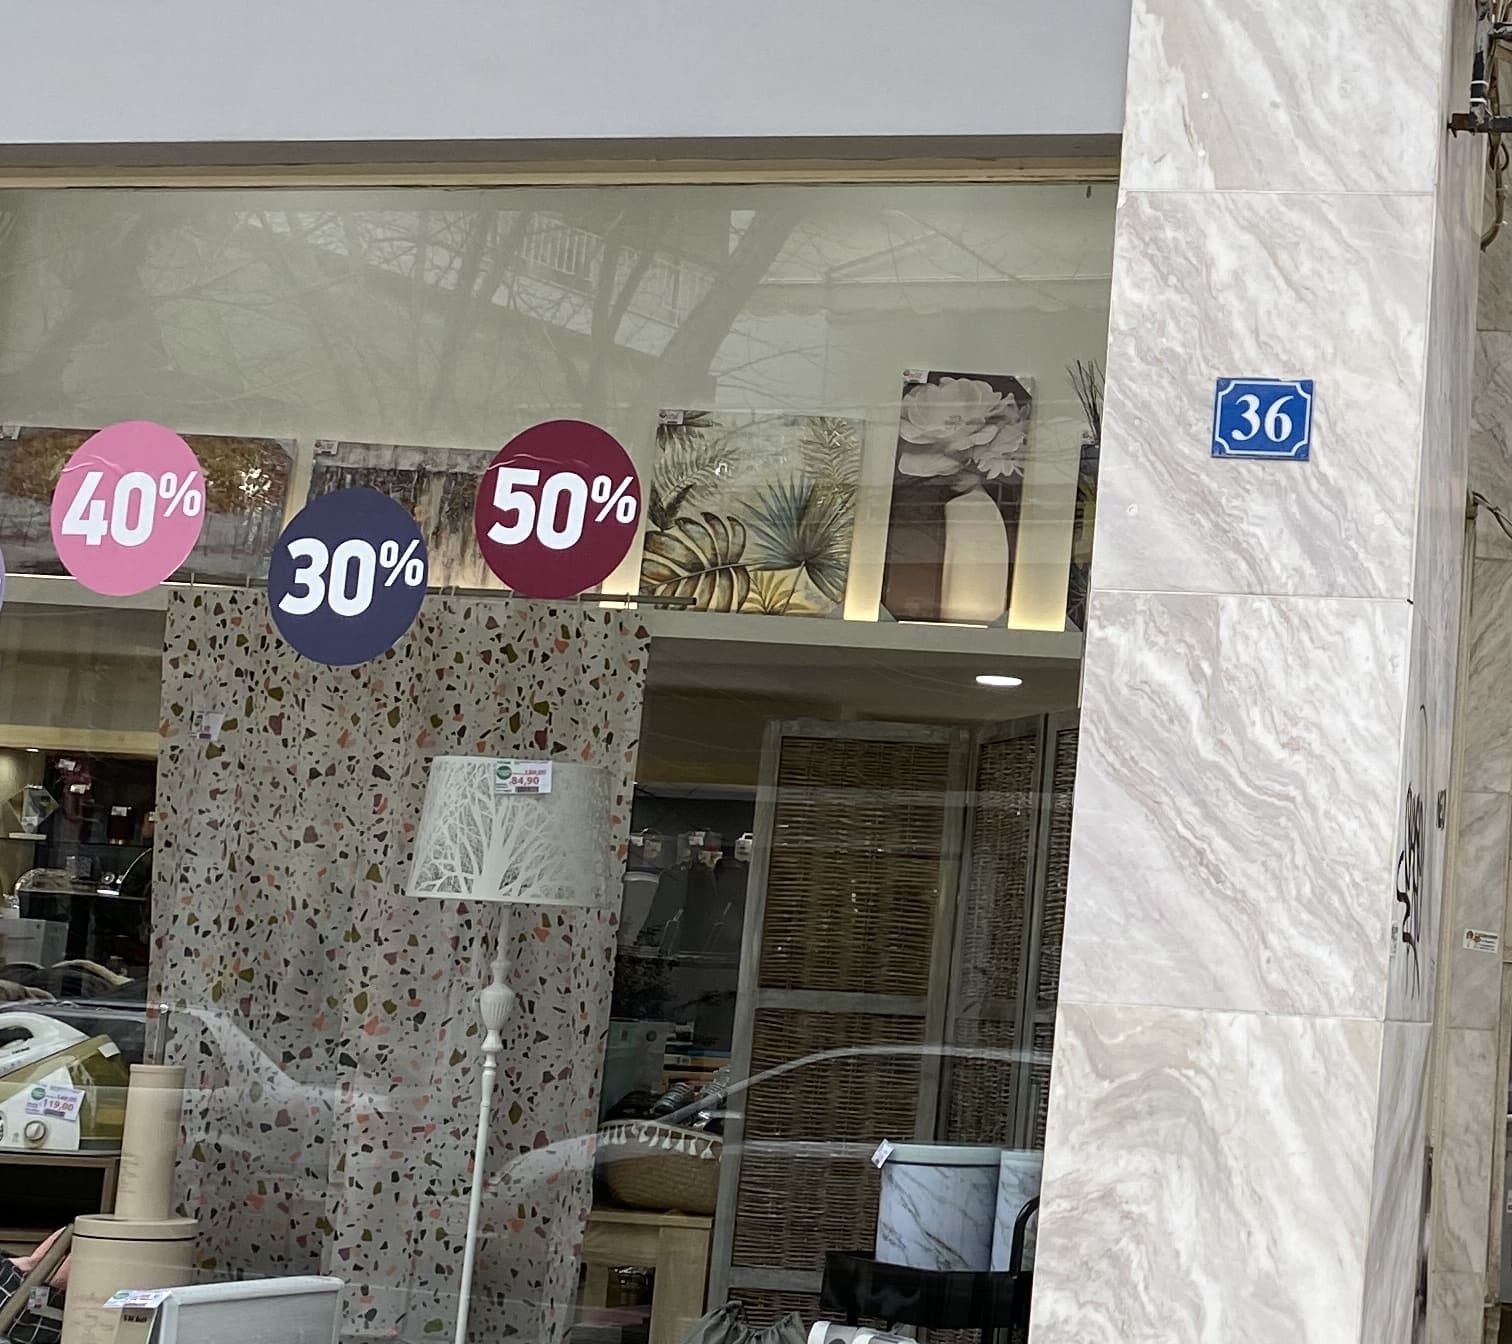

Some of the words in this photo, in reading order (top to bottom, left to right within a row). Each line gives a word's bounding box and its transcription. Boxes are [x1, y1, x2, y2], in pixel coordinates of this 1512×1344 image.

[1231, 393, 1295, 443] 36
[60, 470, 203, 548] 40%
[486, 466, 639, 551] 50%
[277, 537, 426, 618] 30%
